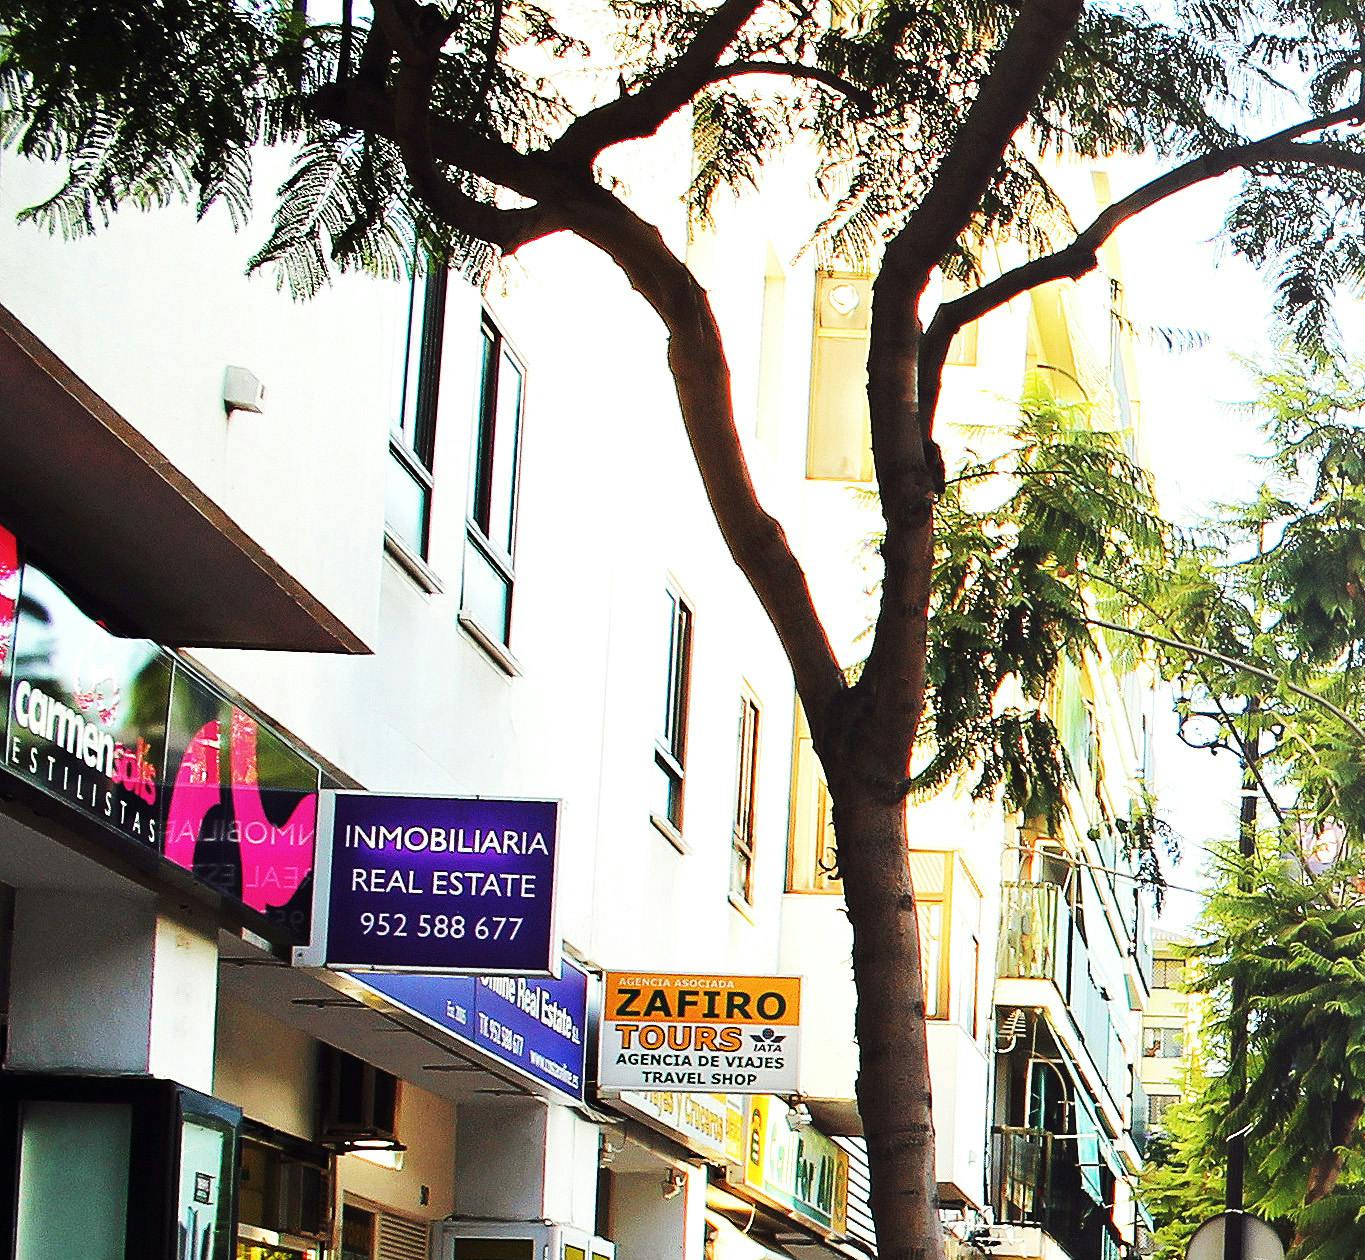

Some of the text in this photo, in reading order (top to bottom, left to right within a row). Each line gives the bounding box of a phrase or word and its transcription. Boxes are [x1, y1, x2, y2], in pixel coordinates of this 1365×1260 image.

[12, 736, 156, 843] ESTILISTAS
[345, 825, 548, 855] INMOBILIARIA
[352, 869, 537, 898] REAL ESTATE
[360, 913, 524, 941] 952 588 677
[619, 978, 735, 989] AGENCIA ASOCIADA
[516, 978, 540, 1019] Real
[542, 992, 572, 1039] Estate
[616, 989, 787, 1020] ZAFIRO
[615, 1024, 782, 1053] TOURS IATA
[616, 1054, 785, 1070] AGENCIA DE VIAJES
[642, 1071, 757, 1086] TRAVEL SHOP
